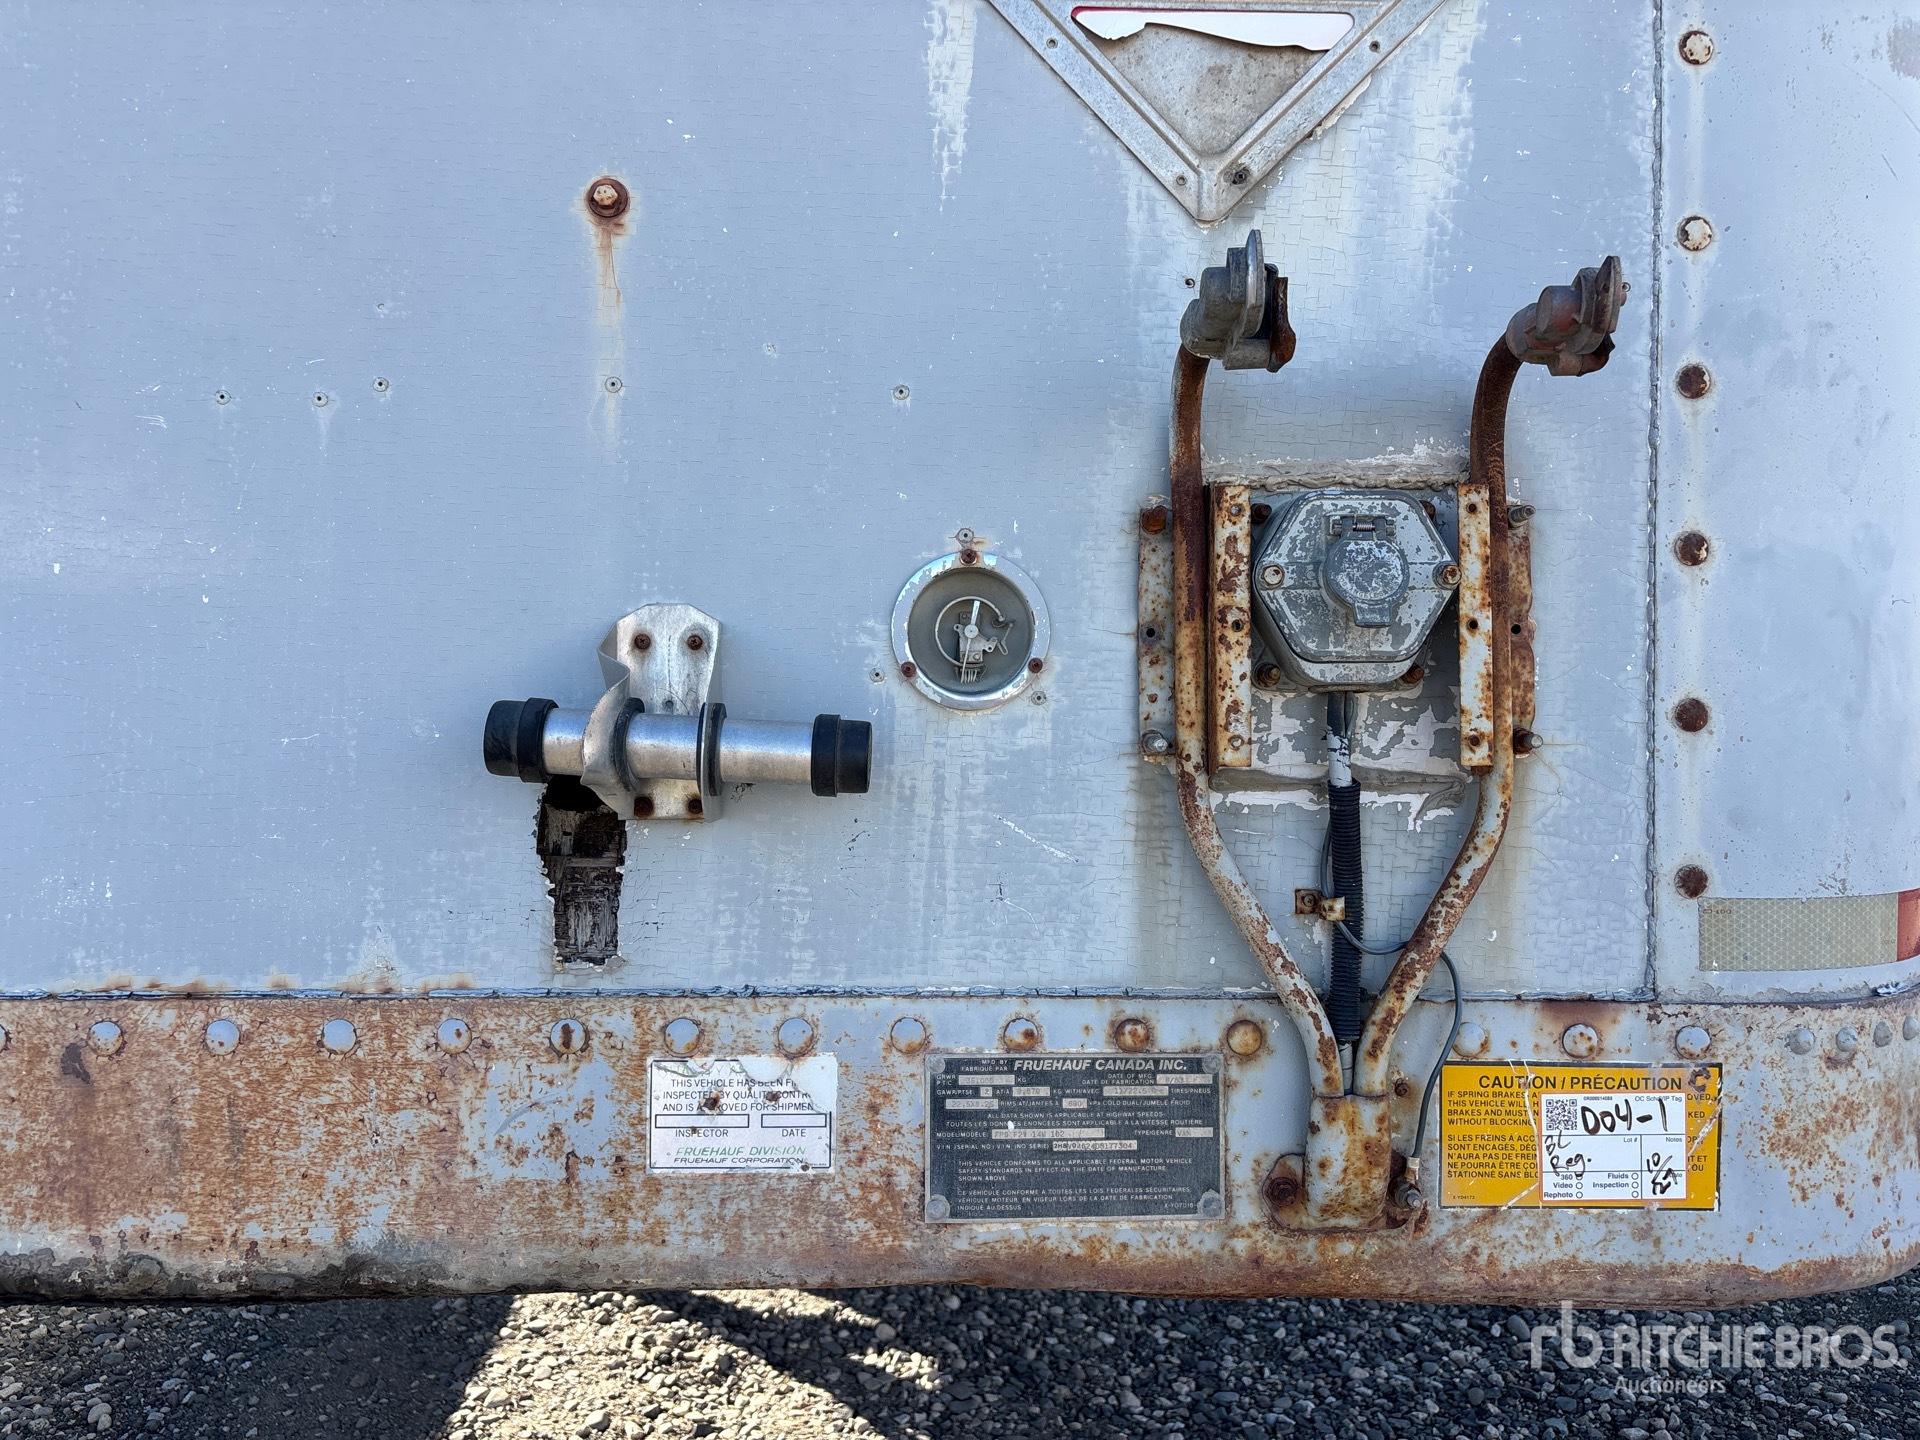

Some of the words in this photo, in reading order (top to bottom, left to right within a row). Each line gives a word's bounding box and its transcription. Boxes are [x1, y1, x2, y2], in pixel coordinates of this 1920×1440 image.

[1014, 1060, 1091, 1071] FRUEHAUF
[1095, 1060, 1155, 1071] CANADA
[1159, 1060, 1187, 1071] INC.
[672, 1079, 692, 1088] THIS
[695, 1079, 734, 1088] VEHICLE
[737, 1078, 756, 1088] HAS
[1478, 1075, 1557, 1090] CAUTION
[1570, 1074, 1682, 1090] PRÉCAUTION
[733, 1090, 773, 1099] QUALIT
[778, 1090, 811, 1099] CONTR
[1458, 1091, 1490, 1099] SPRING
[662, 1104, 683, 1112] AND
[686, 1103, 694, 1112] IS
[697, 1103, 748, 1112] AOVED
[751, 1103, 770, 1111] FOR
[772, 1103, 814, 1111] SHIPMEN
[1448, 1100, 1467, 1108] THIS
[1469, 1100, 1506, 1108] VEHICLE
[1508, 1100, 1527, 1108] WILL
[1448, 1109, 1482, 1117] BRAKES
[1484, 1109, 1503, 1117] AND
[1505, 1109, 1527, 1117] MUST
[1448, 1118, 1488, 1126] WITHOUT
[675, 1129, 729, 1138] INSPECTOR
[782, 1129, 806, 1138] DATE
[676, 1146, 745, 1156] FRUEHAUF
[749, 1146, 806, 1156] DIVISION
[1520, 1142, 1537, 1151] DÉG
[1498, 1171, 1522, 1179] SANS
[1592, 1182, 1629, 1190] Inspection
[1544, 1191, 1574, 1199] Rephoto
